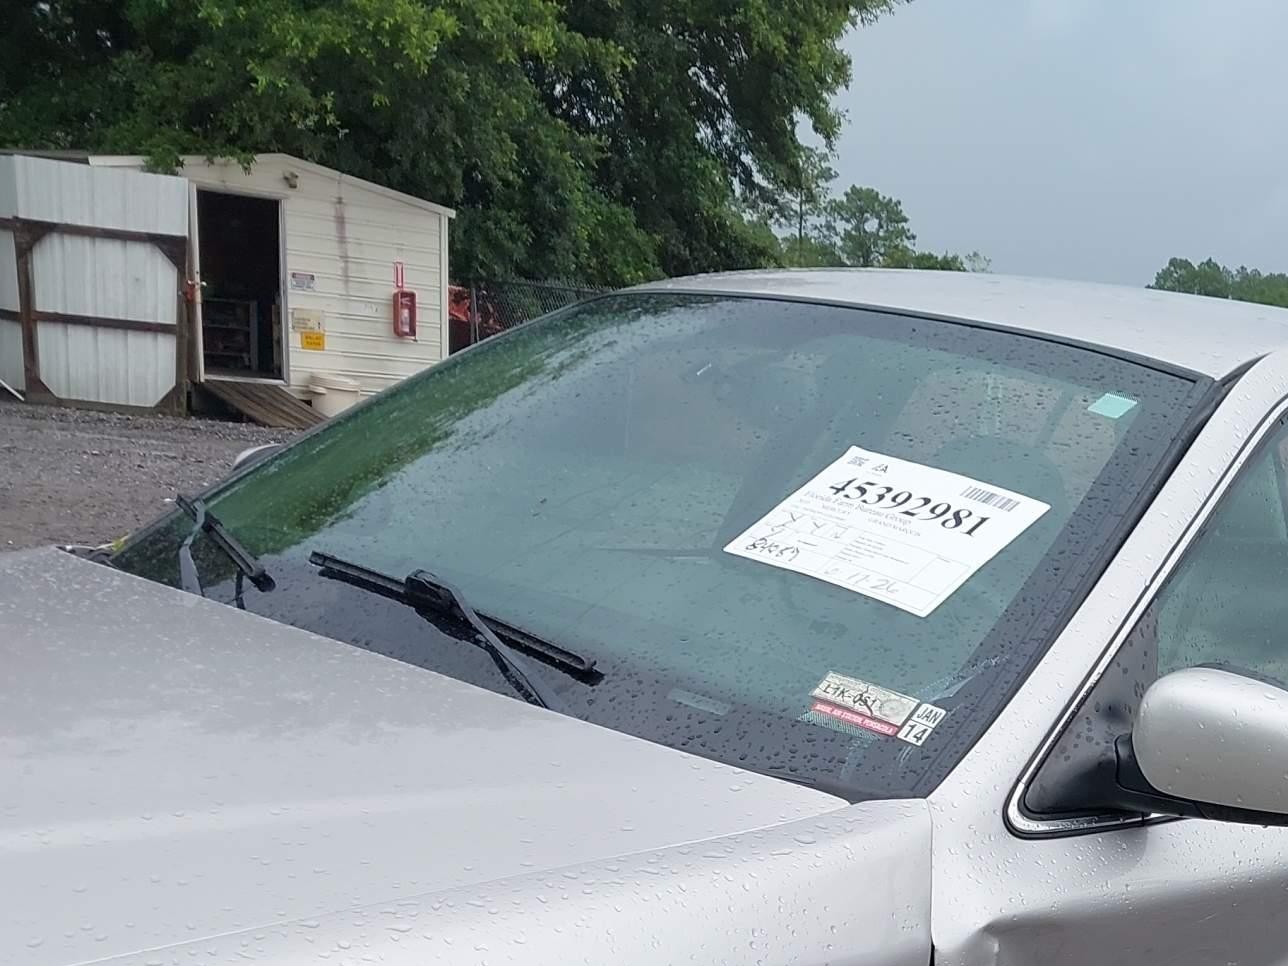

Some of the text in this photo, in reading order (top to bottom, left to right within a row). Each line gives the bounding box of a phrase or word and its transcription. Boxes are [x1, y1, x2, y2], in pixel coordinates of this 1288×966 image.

[829, 477, 991, 537] 45392981
[916, 705, 940, 725] JAN
[903, 724, 929, 743] 14
